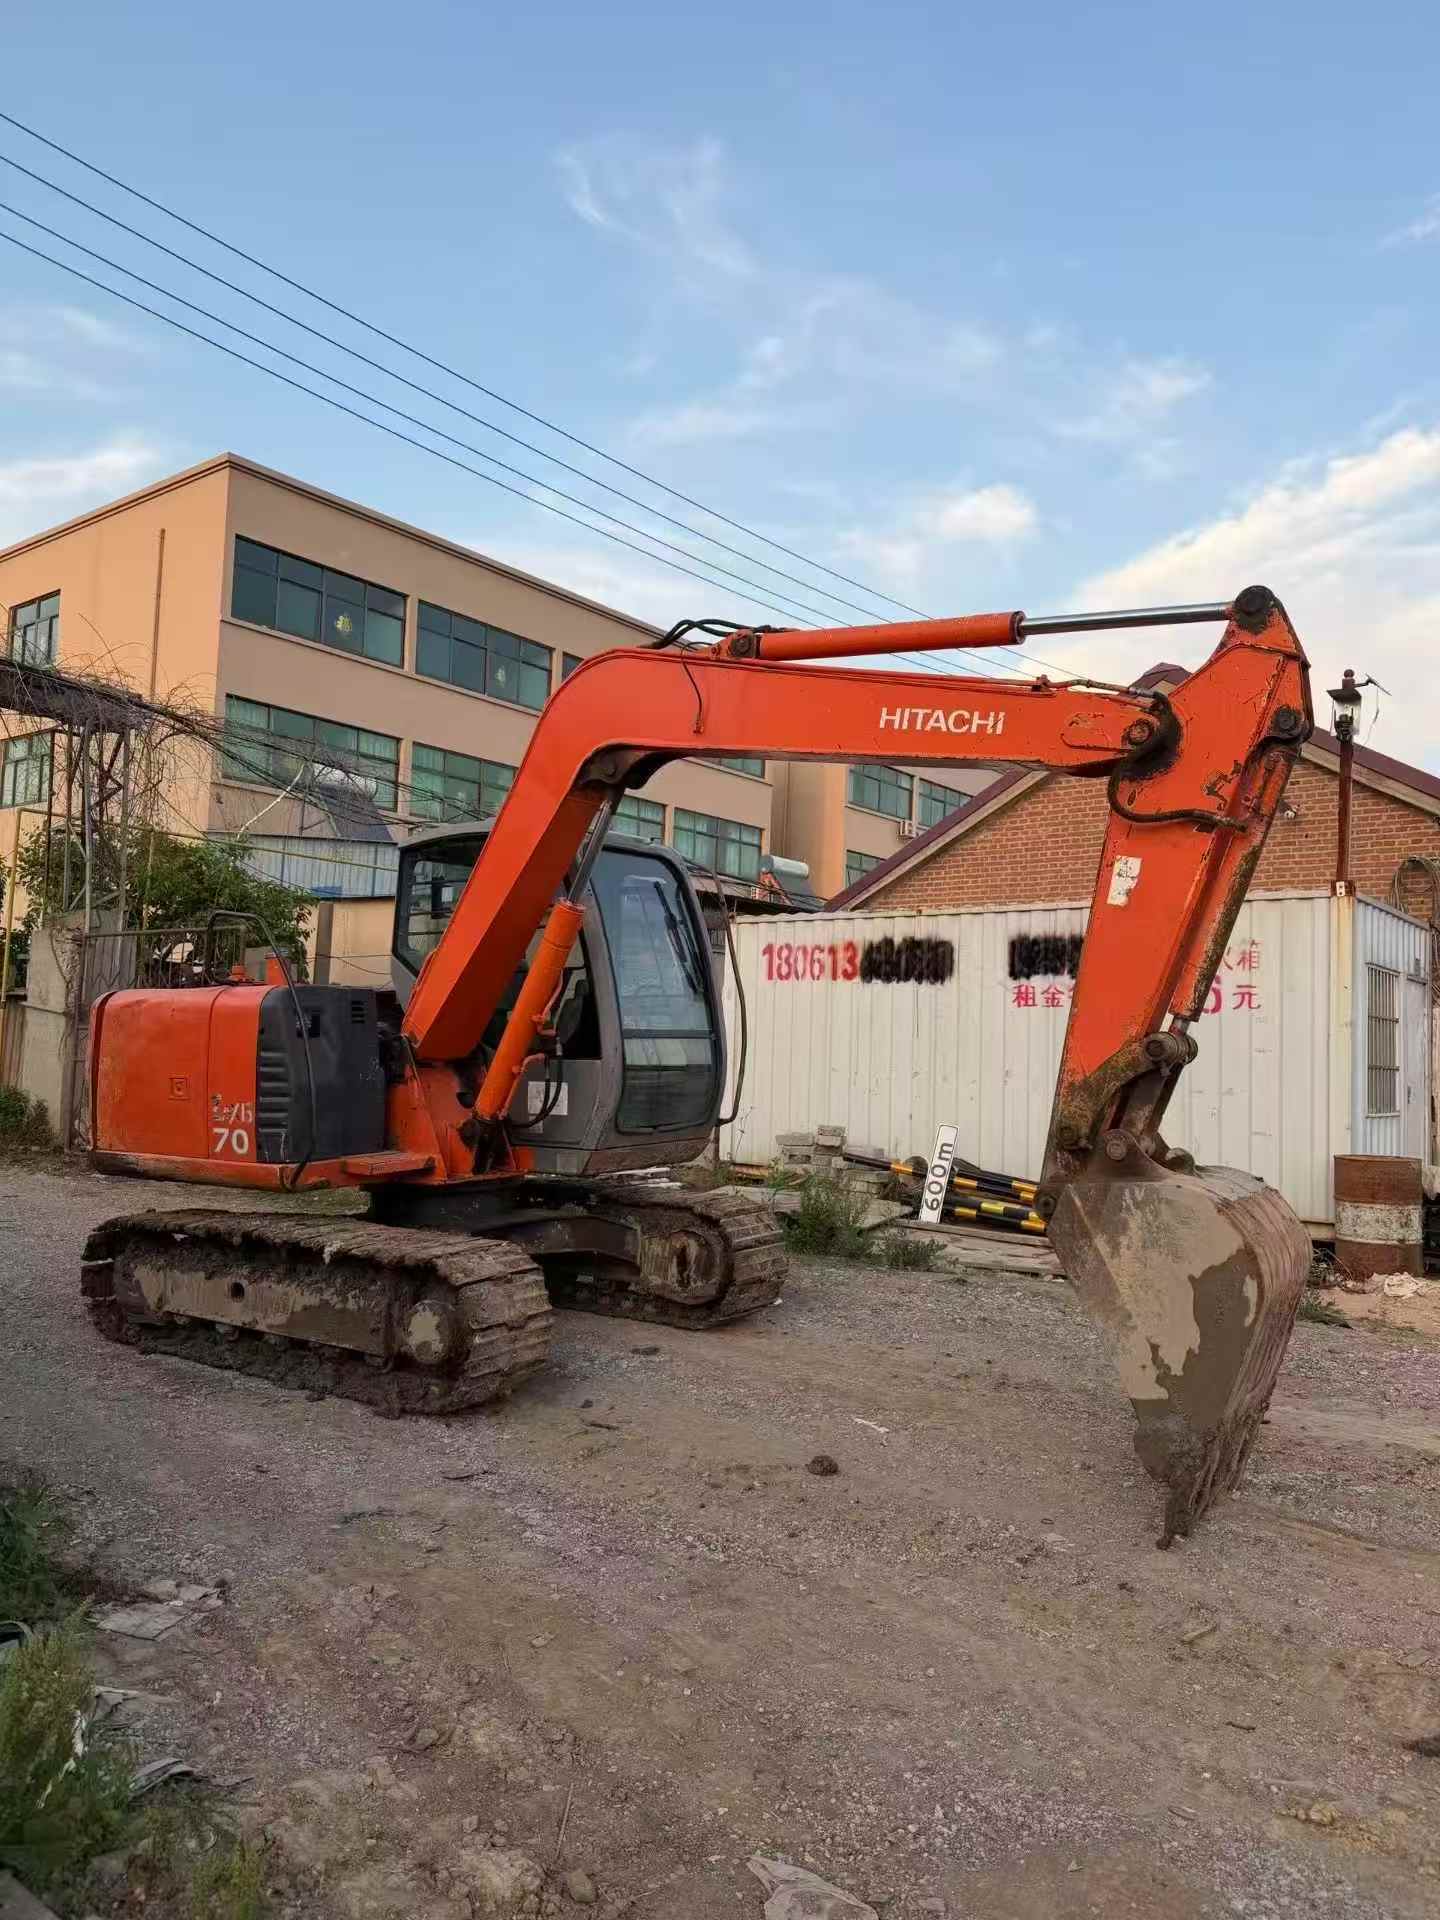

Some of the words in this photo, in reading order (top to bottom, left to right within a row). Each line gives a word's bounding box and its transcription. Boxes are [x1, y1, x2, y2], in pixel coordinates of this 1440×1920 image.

[880, 707, 1005, 734] HITACHI
[1012, 984, 1074, 1008] 租金
[212, 1127, 249, 1154] 70
[925, 1143, 953, 1211] 600m
